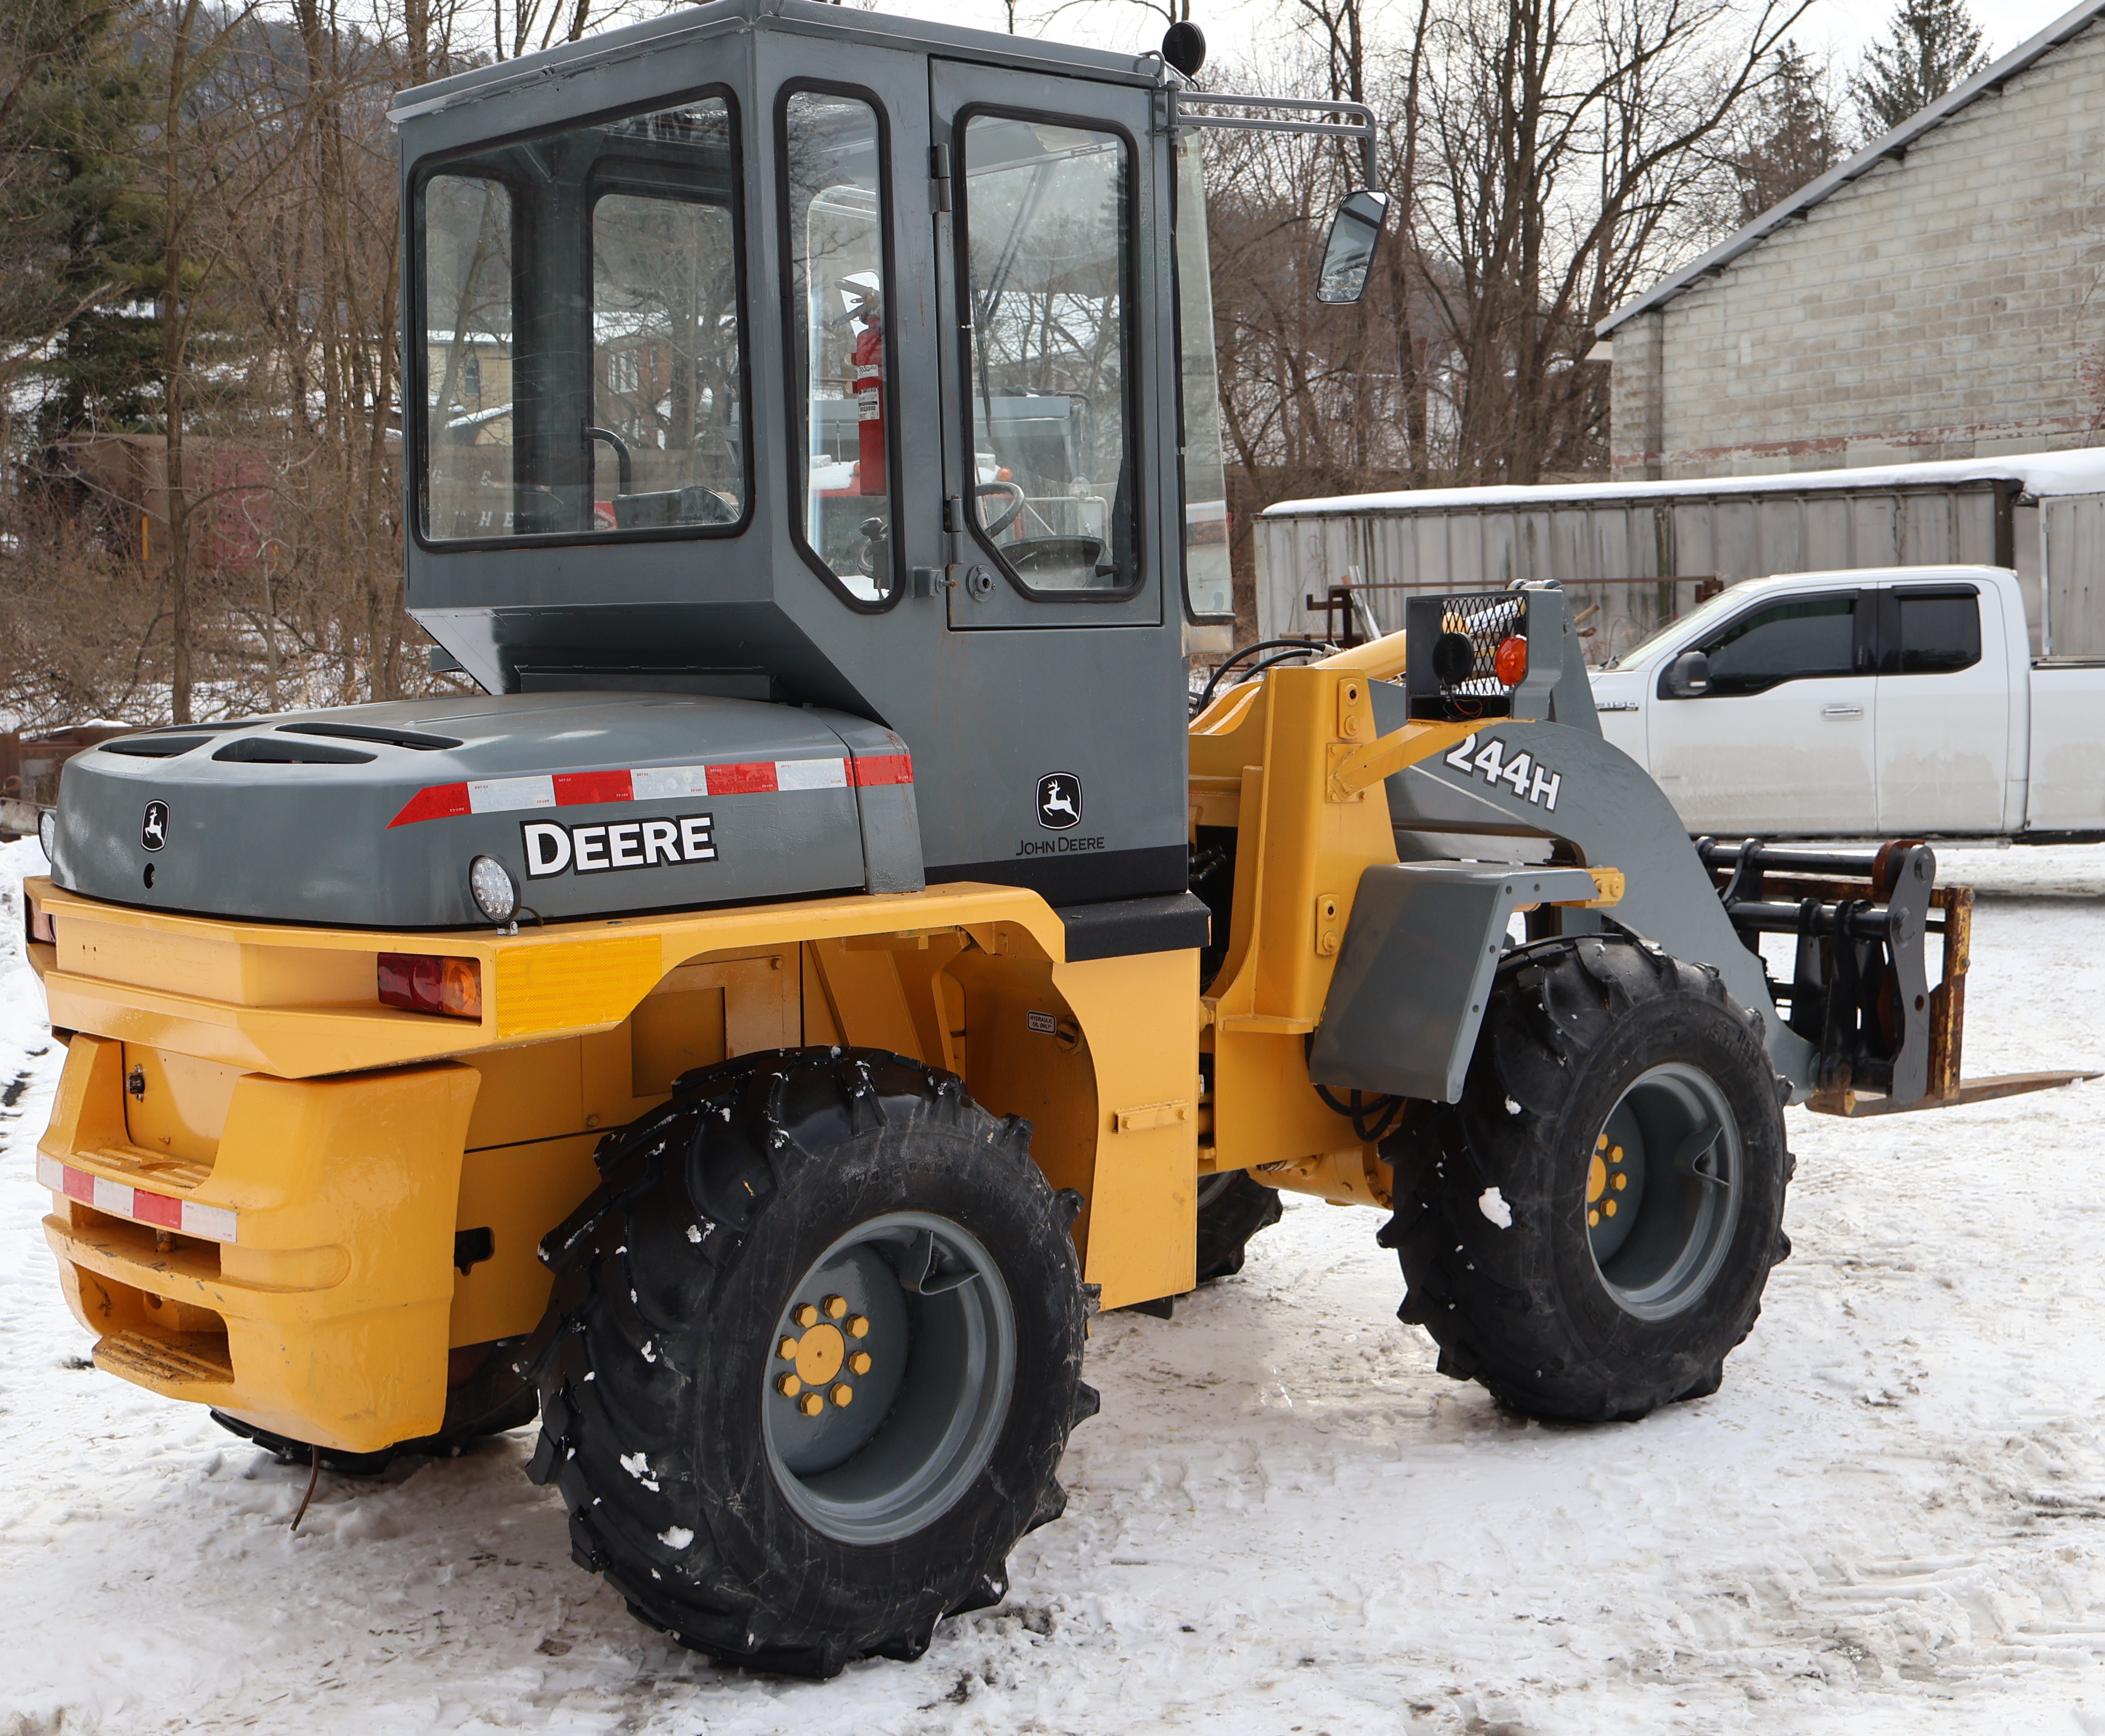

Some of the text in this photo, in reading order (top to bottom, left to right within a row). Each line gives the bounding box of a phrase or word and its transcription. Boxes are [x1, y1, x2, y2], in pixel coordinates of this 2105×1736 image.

[1446, 733, 1561, 810] 244H
[524, 817, 715, 875] DEERE
[1016, 837, 1105, 856] JOHN DEERE
[1030, 1015, 1053, 1023] HYDRAULIC
